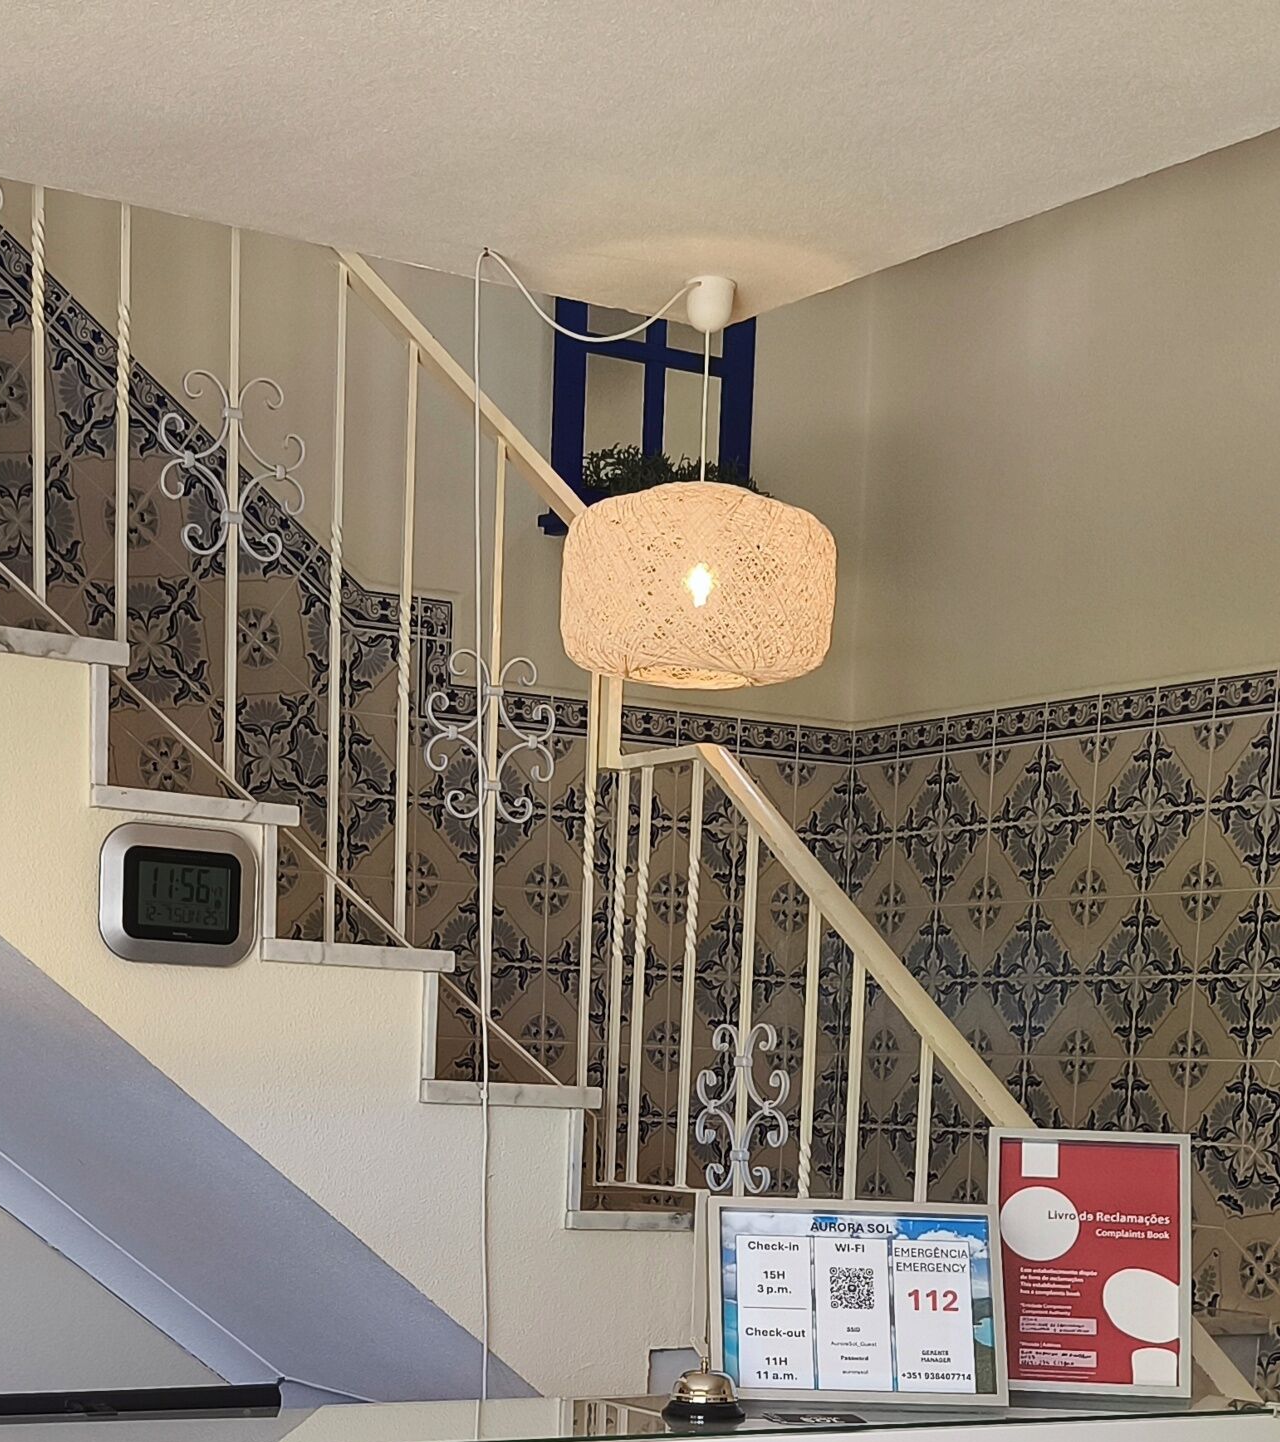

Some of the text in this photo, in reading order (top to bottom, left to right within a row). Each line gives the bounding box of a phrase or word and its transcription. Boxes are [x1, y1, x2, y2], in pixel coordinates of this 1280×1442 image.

[152, 866, 210, 903] 11:56
[1048, 1210, 1170, 1226] Livro de Reclamações
[810, 1221, 894, 1235] AURORA SOL
[1095, 1229, 1170, 1240] Complaints Book
[747, 1240, 800, 1252] Check-in
[835, 1243, 865, 1253] WI-FI
[894, 1247, 969, 1259] EMERGÊNCIA
[896, 1262, 967, 1273] EMERGENCY
[763, 1270, 786, 1280] 15H
[757, 1284, 792, 1295] 3 p.m.
[907, 1288, 959, 1312] 112
[745, 1327, 806, 1338] Check-out
[765, 1357, 788, 1366] 11H
[756, 1370, 798, 1381] 11 a.m.
[901, 1372, 922, 1380] +351
